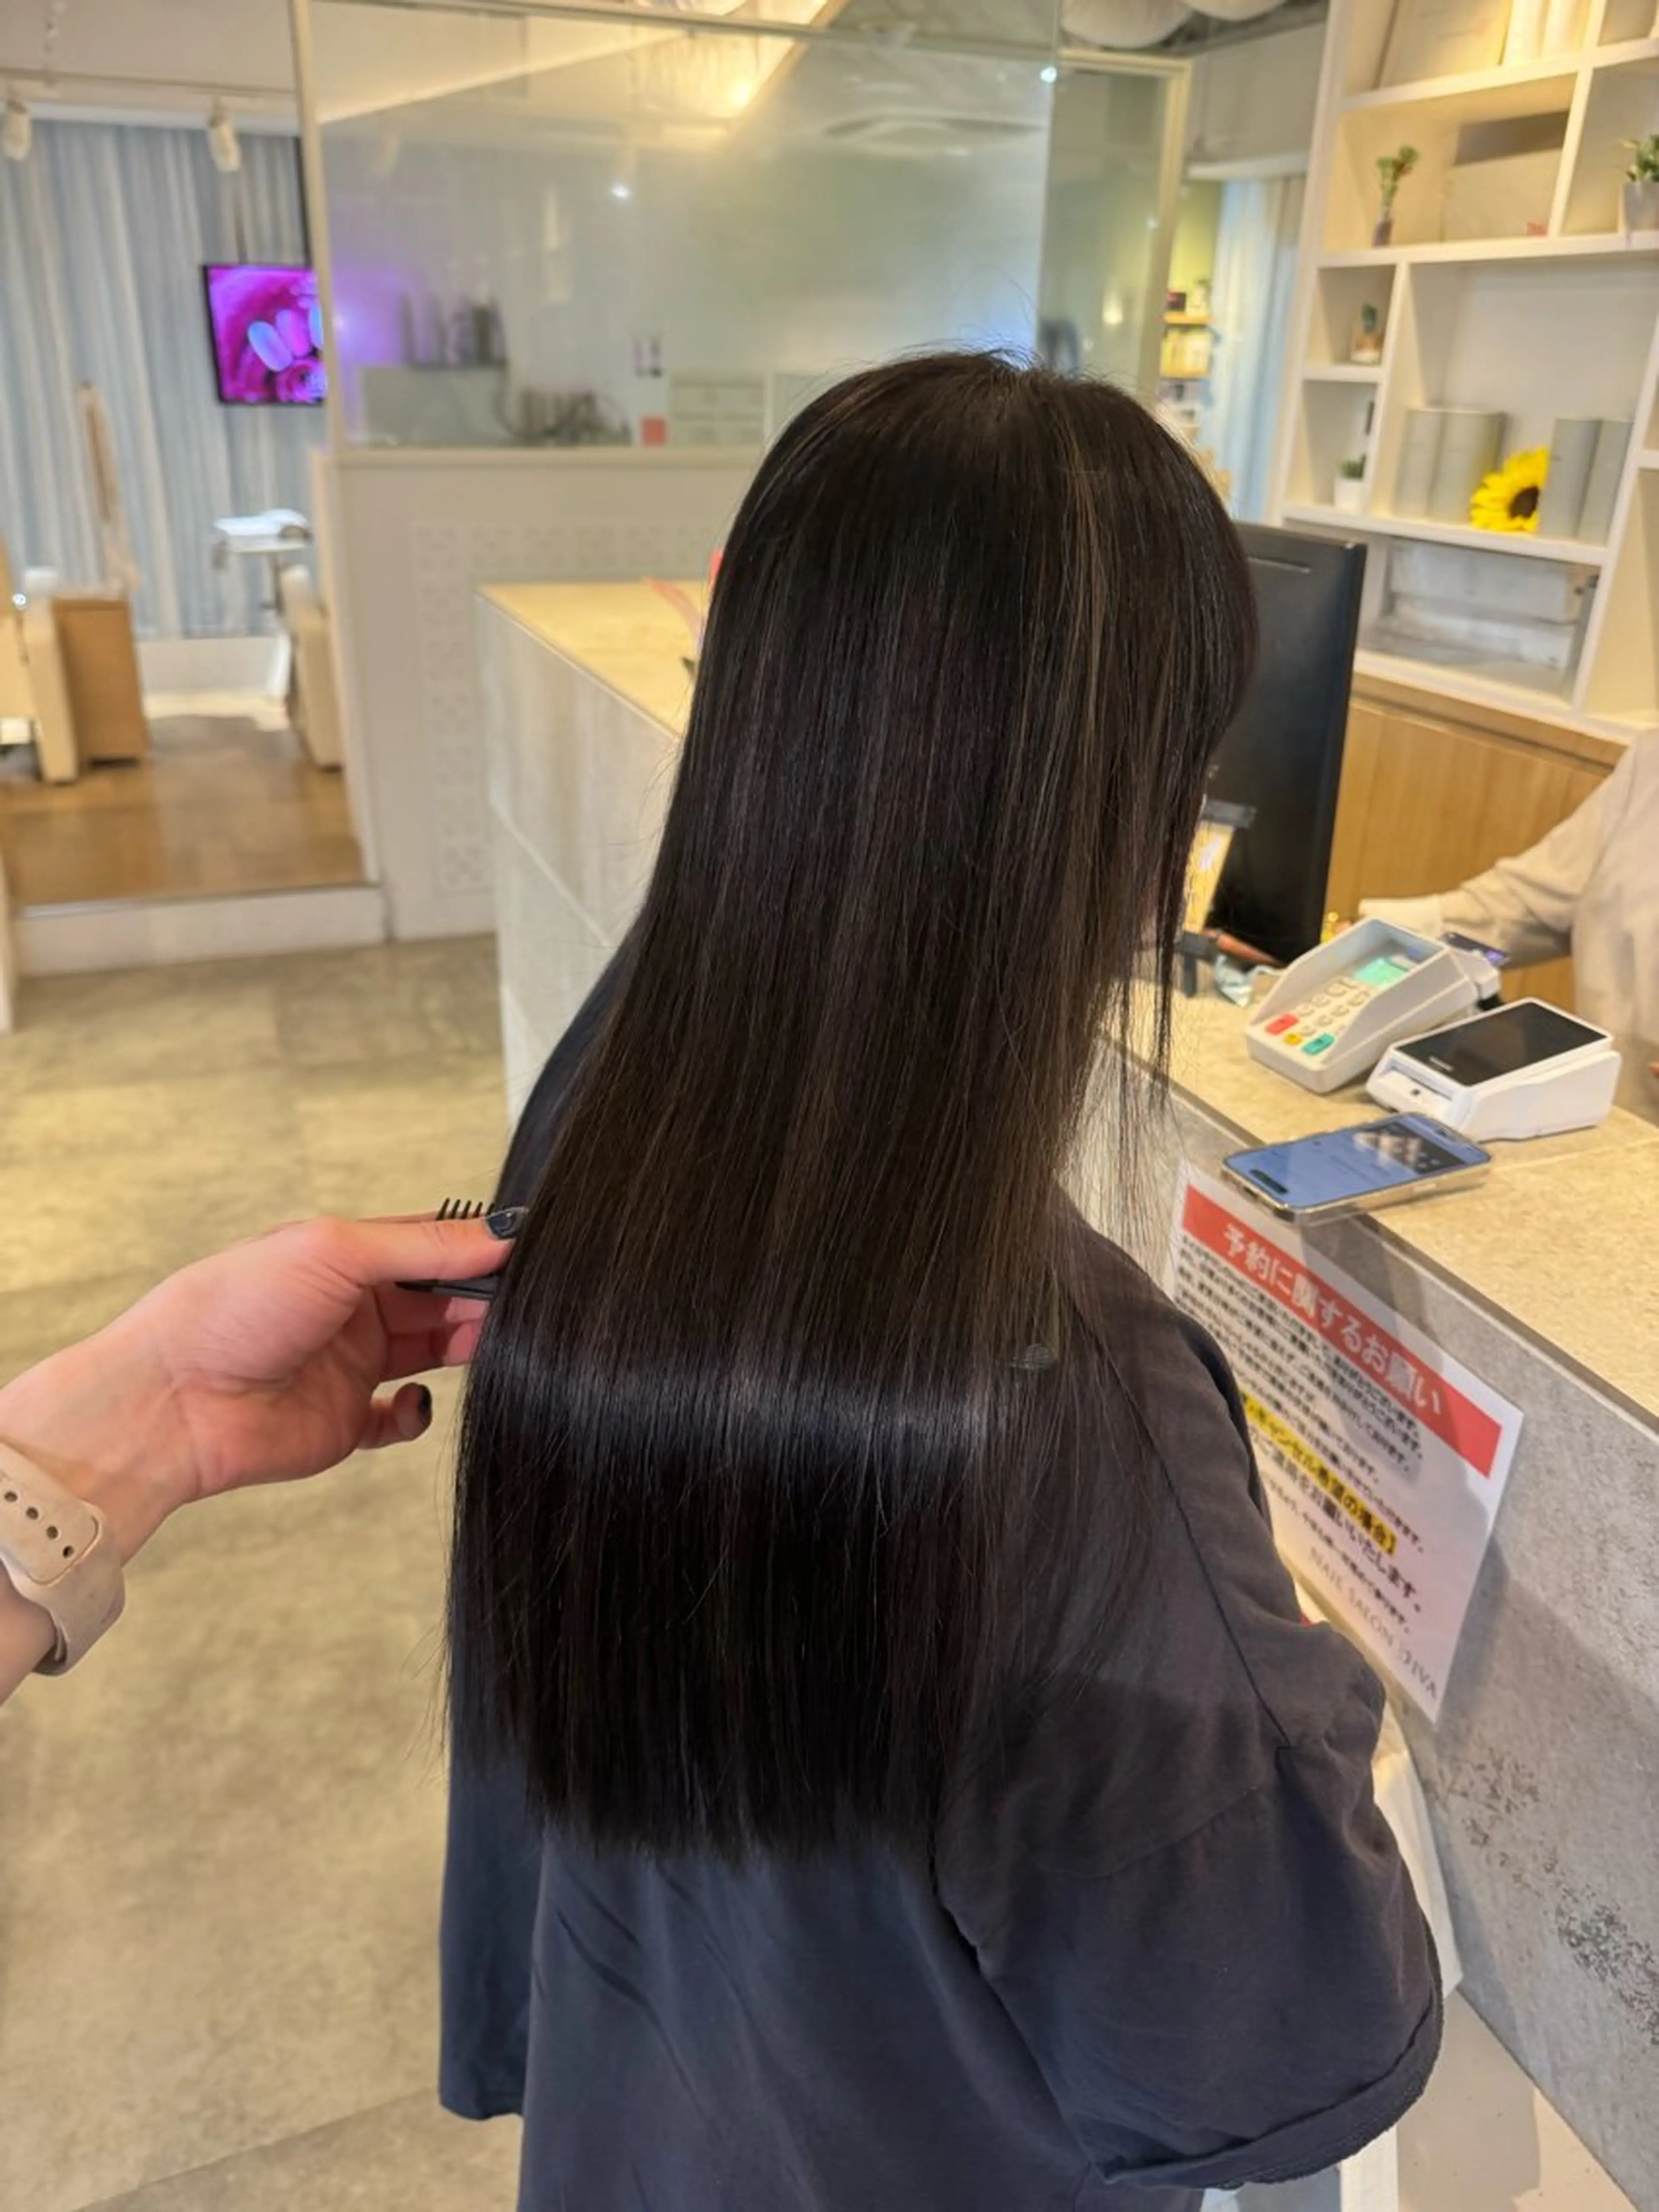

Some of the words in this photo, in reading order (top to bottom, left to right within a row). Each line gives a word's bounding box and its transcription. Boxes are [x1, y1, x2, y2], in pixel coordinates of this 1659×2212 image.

[1224, 1224, 1441, 1417] 予約に関するお願い
